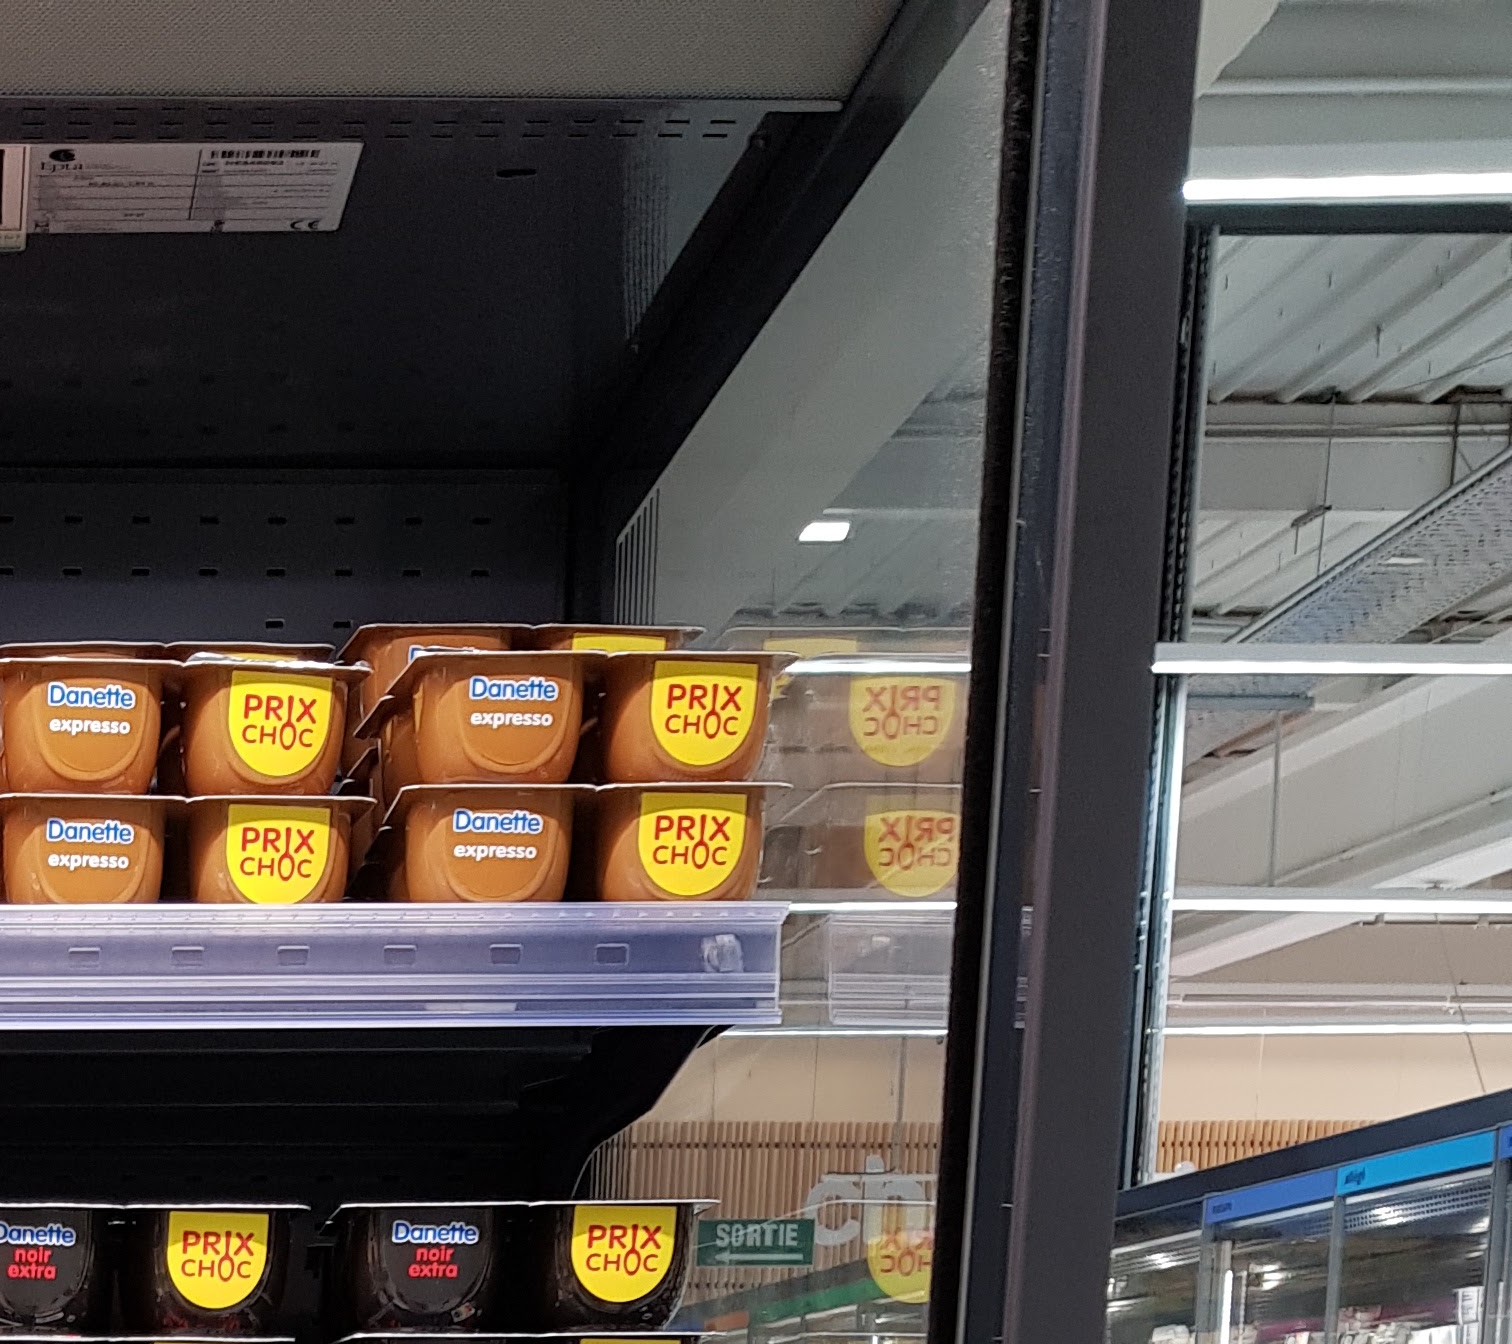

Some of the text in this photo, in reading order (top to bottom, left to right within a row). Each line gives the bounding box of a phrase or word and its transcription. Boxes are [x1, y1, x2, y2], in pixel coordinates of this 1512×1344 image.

[48, 683, 135, 708] Danette
[50, 718, 130, 735] expresso
[471, 711, 553, 729] expresso
[716, 1224, 798, 1248] SORTIE
[14, 1248, 51, 1263] noir
[8, 1264, 56, 1280] extra
